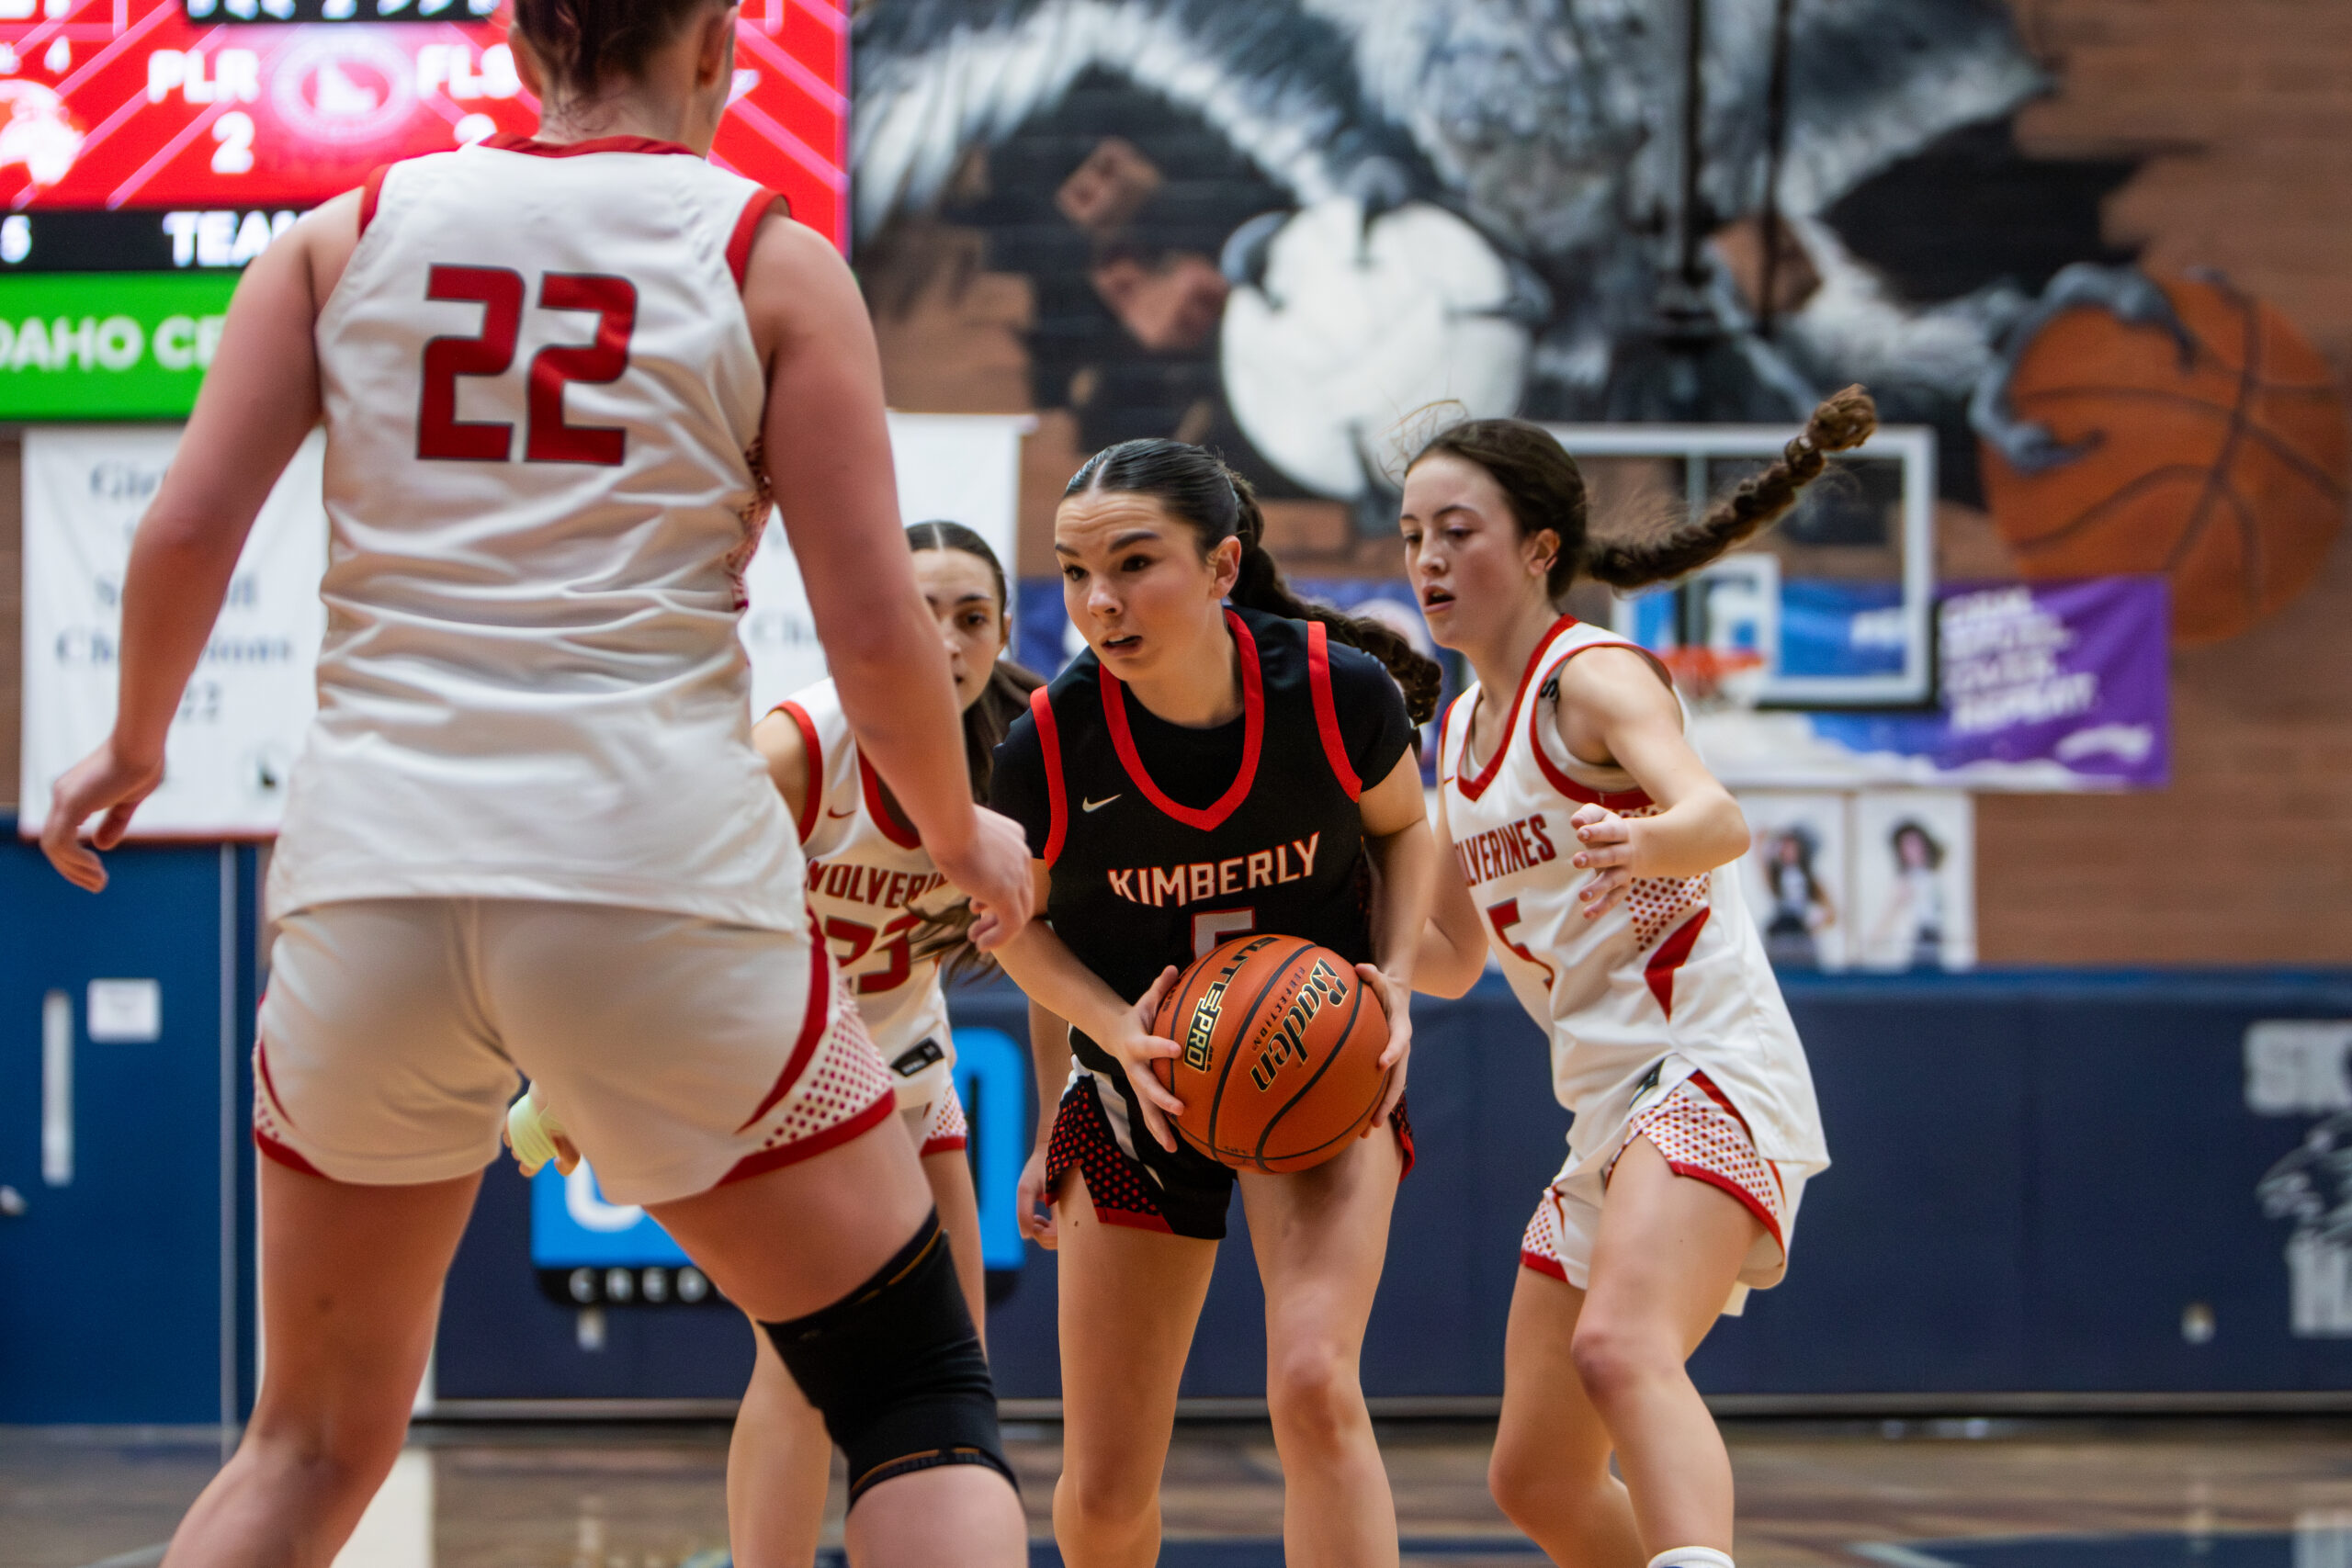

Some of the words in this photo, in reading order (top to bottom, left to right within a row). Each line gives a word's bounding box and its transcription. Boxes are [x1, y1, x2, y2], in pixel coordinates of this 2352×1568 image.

[147, 49, 260, 104] PLR
[210, 111, 255, 174] 2
[163, 210, 298, 267] TEA
[416, 262, 639, 468] 22
[1107, 830, 1320, 908] KIMBERLY
[1454, 813, 1557, 887] LVERINES
[1250, 957, 1349, 1092] Baden
[568, 1265, 726, 1305] CRED
